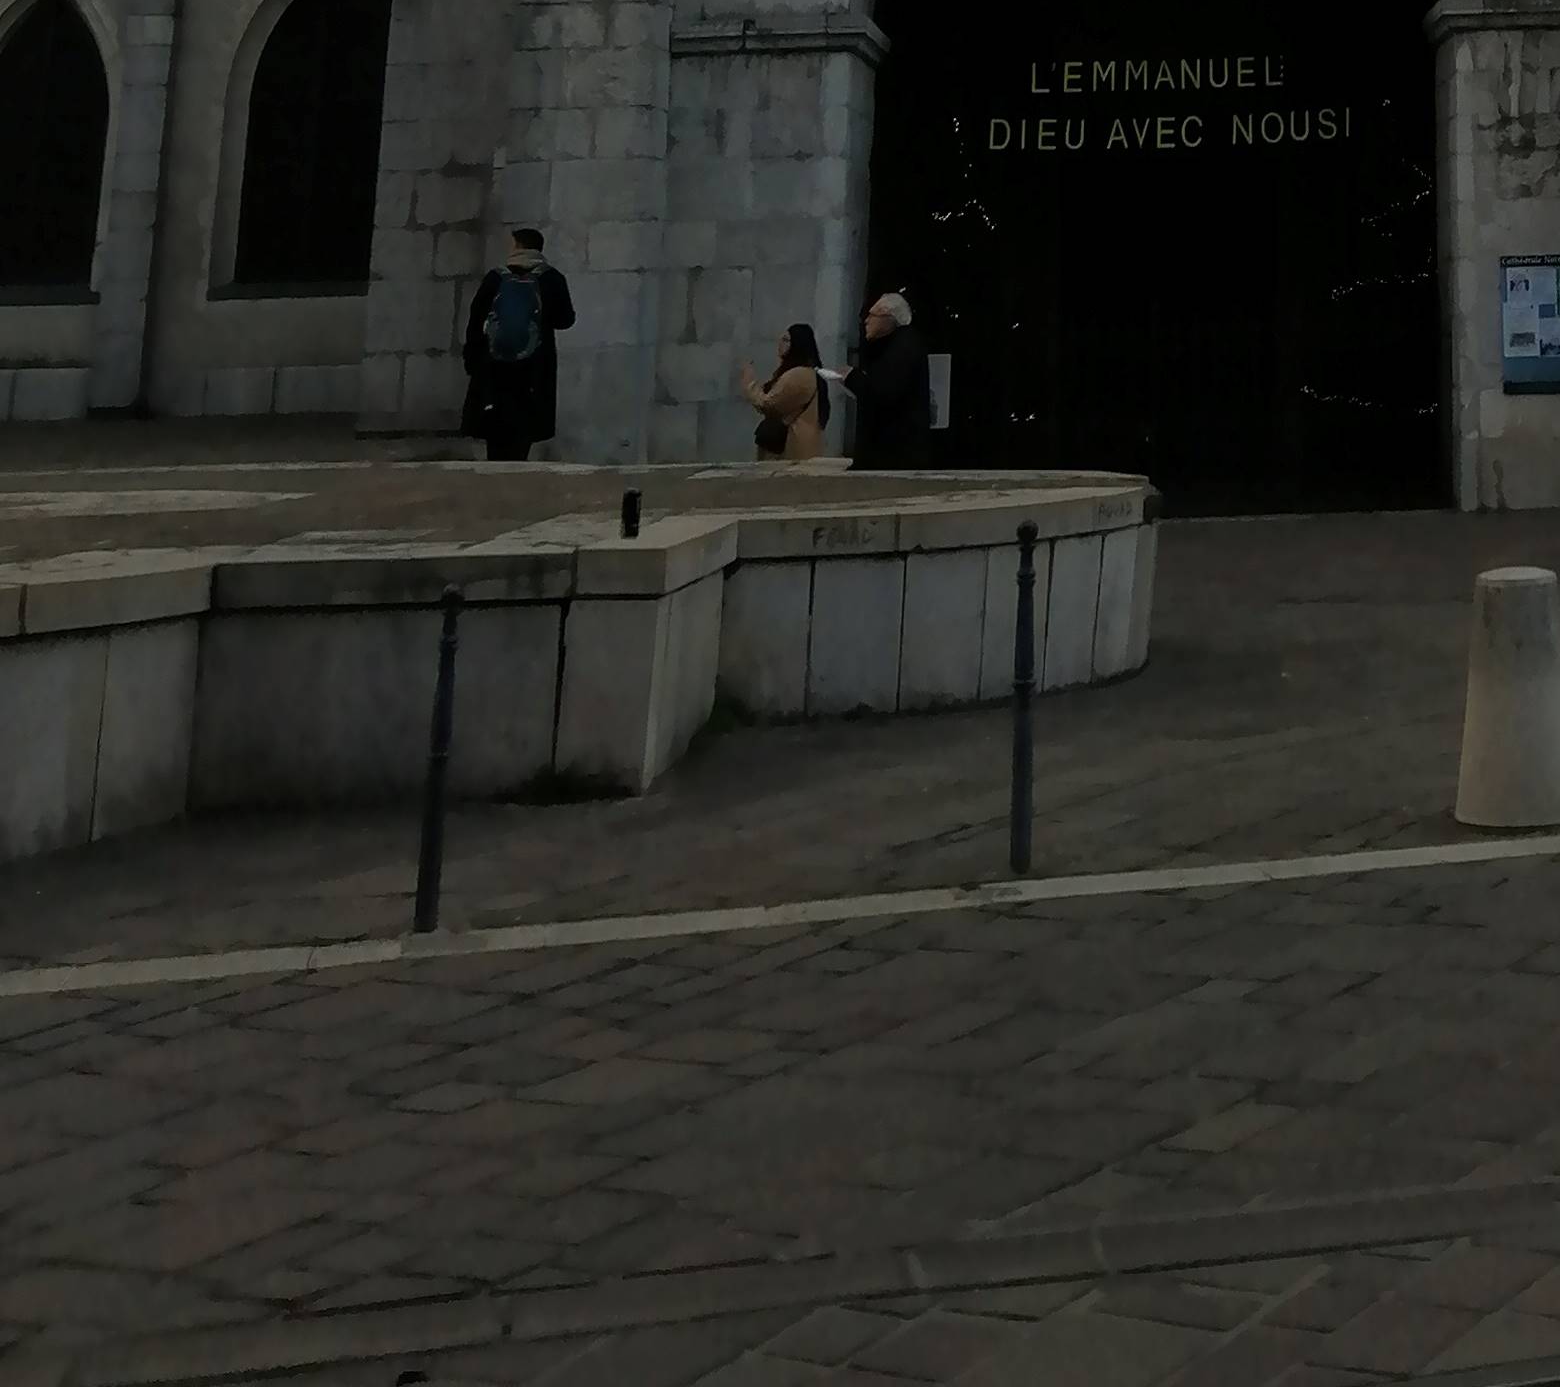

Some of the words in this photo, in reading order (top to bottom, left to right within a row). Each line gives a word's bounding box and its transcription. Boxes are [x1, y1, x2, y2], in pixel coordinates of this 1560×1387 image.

[1029, 55, 1285, 95] L'EMMANUEL
[987, 117, 1087, 152] DIEU
[1105, 114, 1205, 151] AVEC
